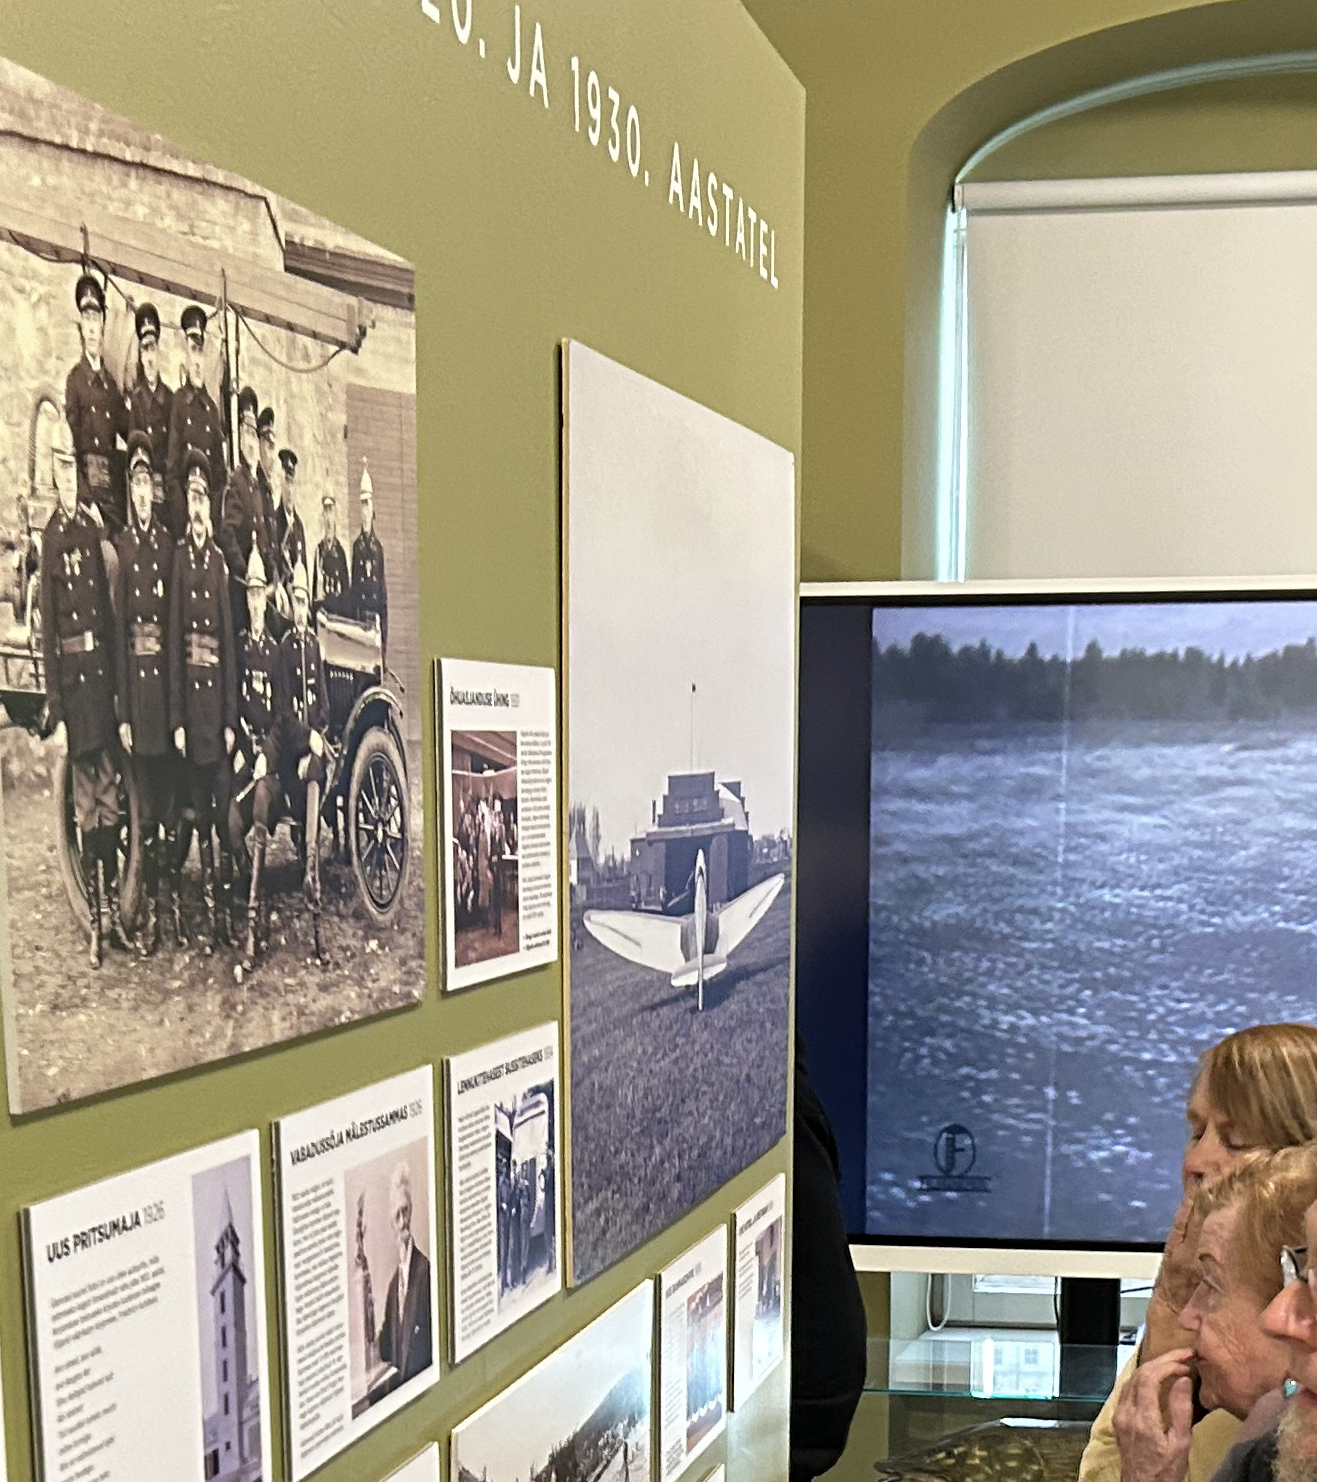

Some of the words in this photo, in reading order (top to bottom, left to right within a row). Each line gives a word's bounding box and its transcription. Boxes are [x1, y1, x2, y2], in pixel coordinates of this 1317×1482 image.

[506, 4, 549, 109] JA
[571, 55, 650, 188] 1930.
[668, 141, 779, 290] AASTATEL
[46, 1237, 71, 1264] UUS
[72, 1210, 142, 1254] PRITSUMAJA
